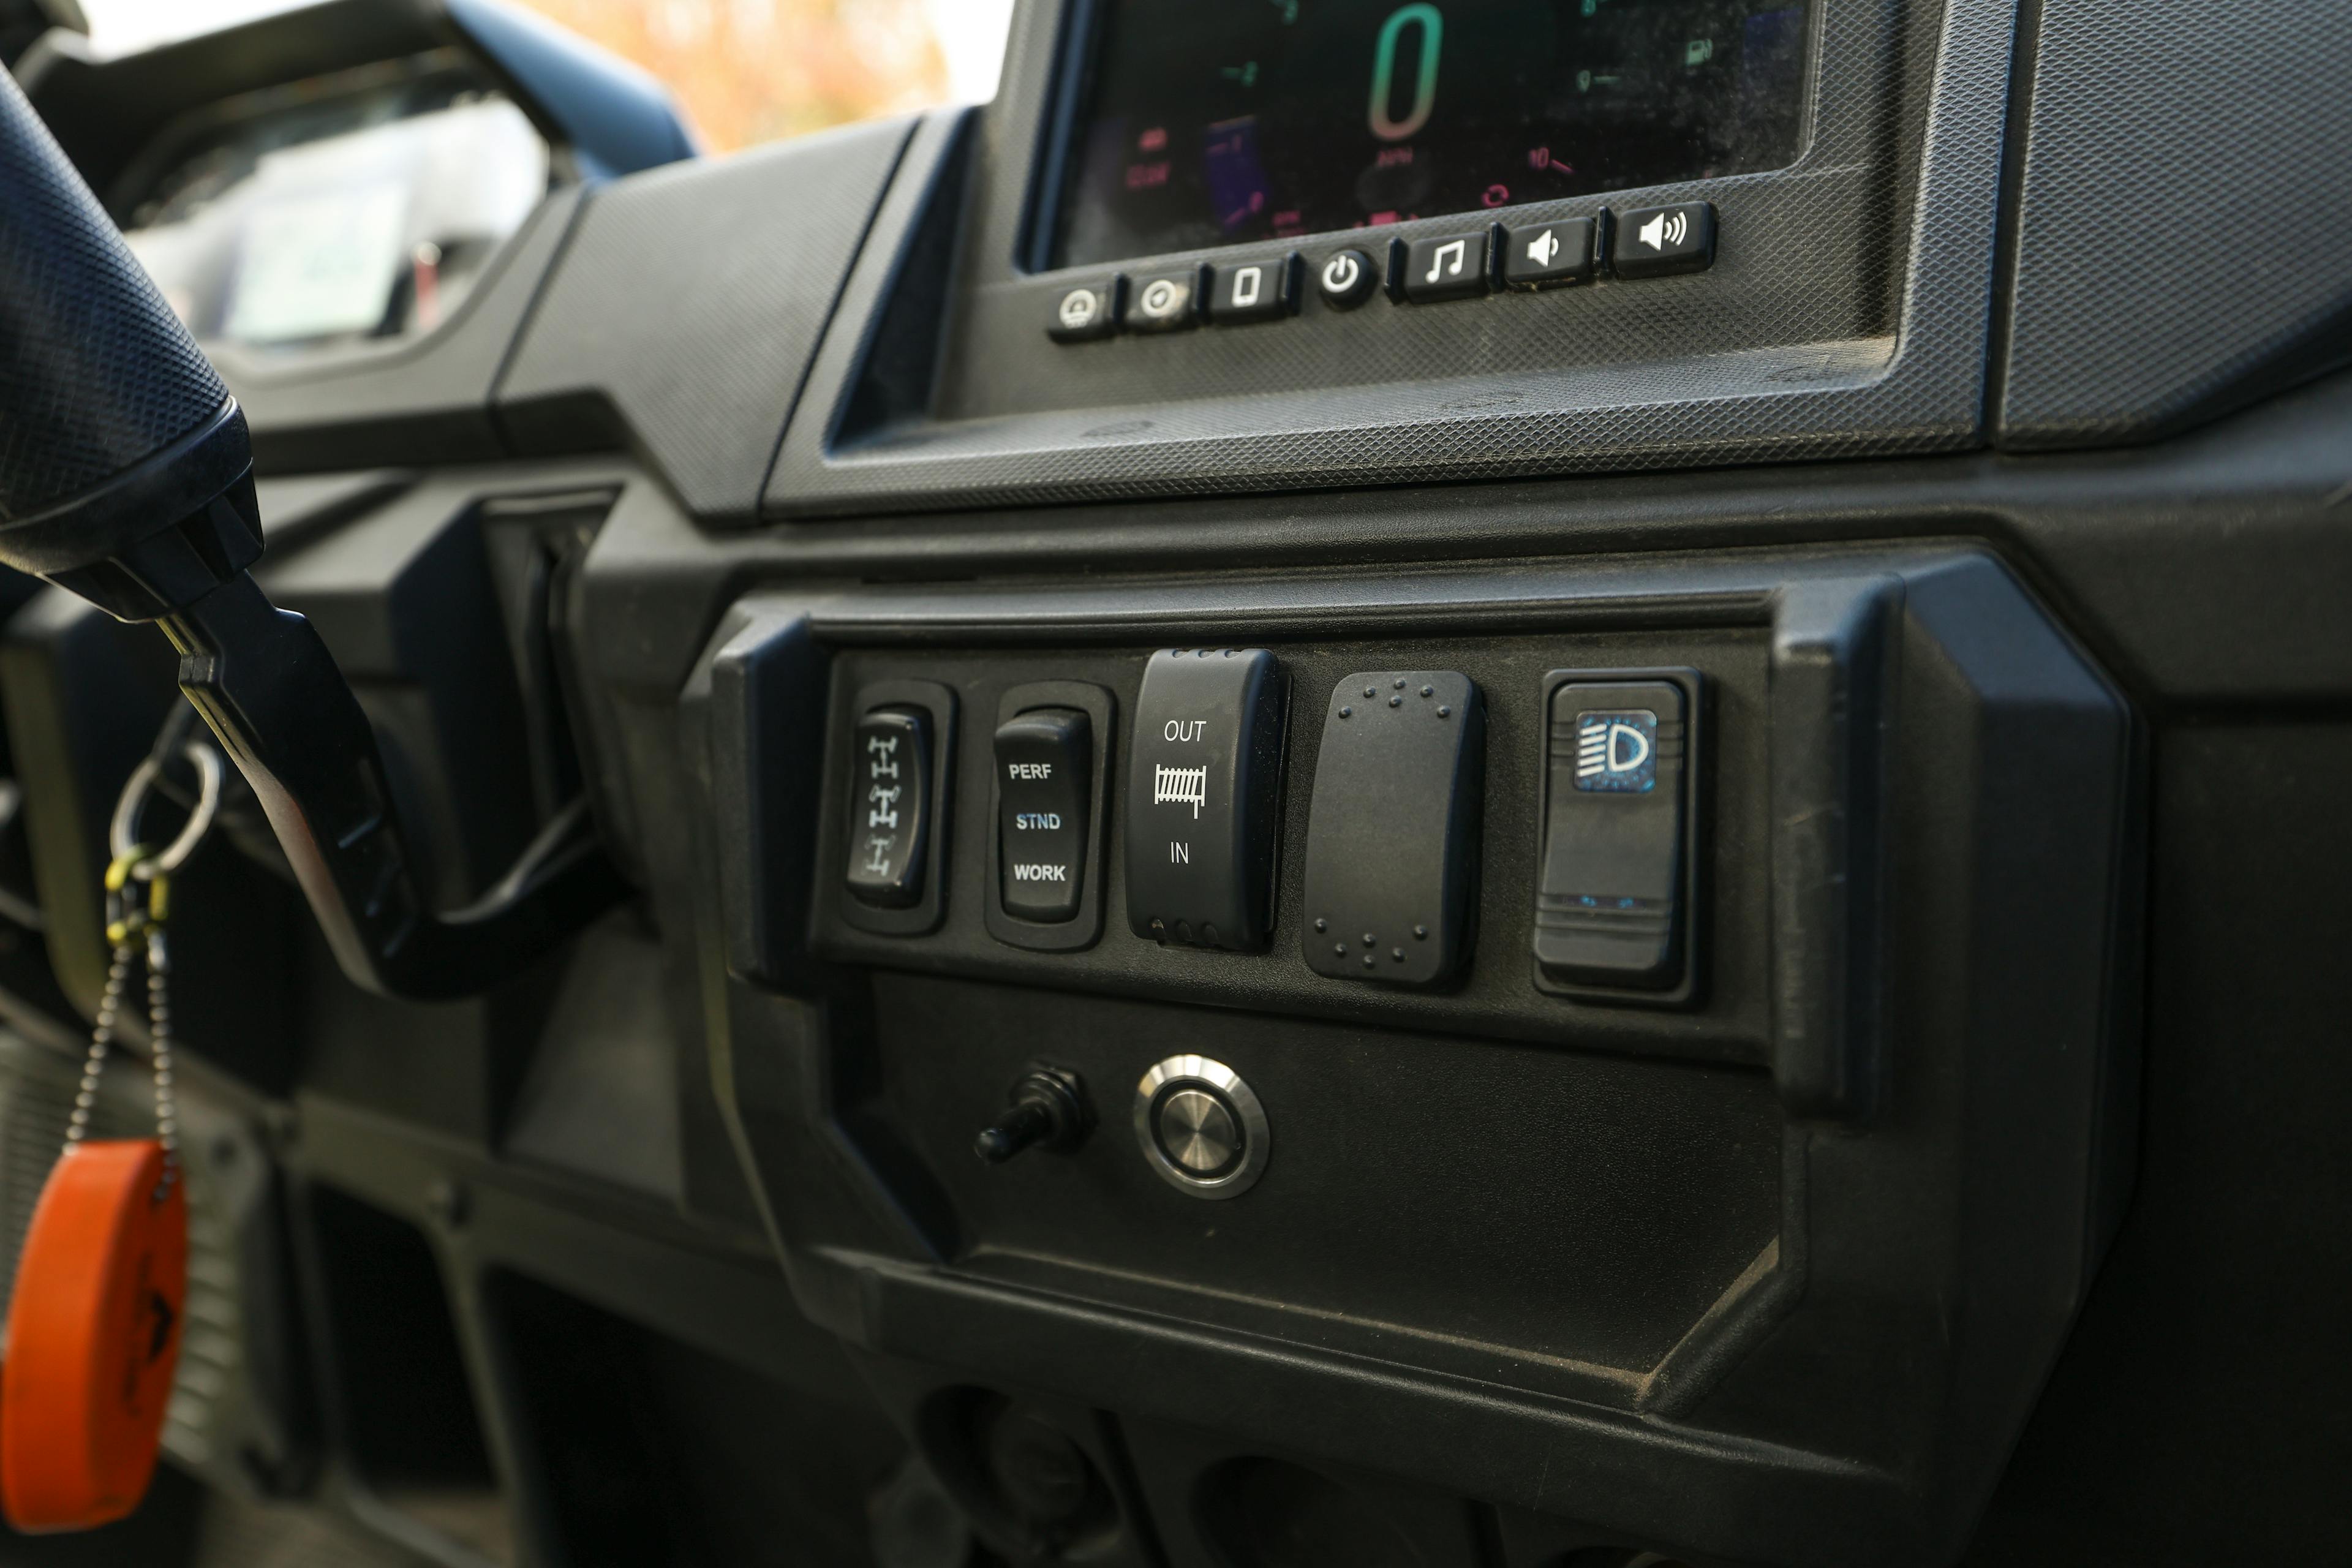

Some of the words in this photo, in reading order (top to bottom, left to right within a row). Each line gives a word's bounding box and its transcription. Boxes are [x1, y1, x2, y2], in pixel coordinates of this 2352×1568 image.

[1368, 2, 1443, 140] 0
[1528, 146, 1549, 170] 10
[1164, 720, 1207, 742] OUT
[1009, 764, 1052, 780] PERF
[1016, 813, 1061, 831] STND
[1170, 841, 1189, 864] IN
[1014, 864, 1066, 882] WORK
